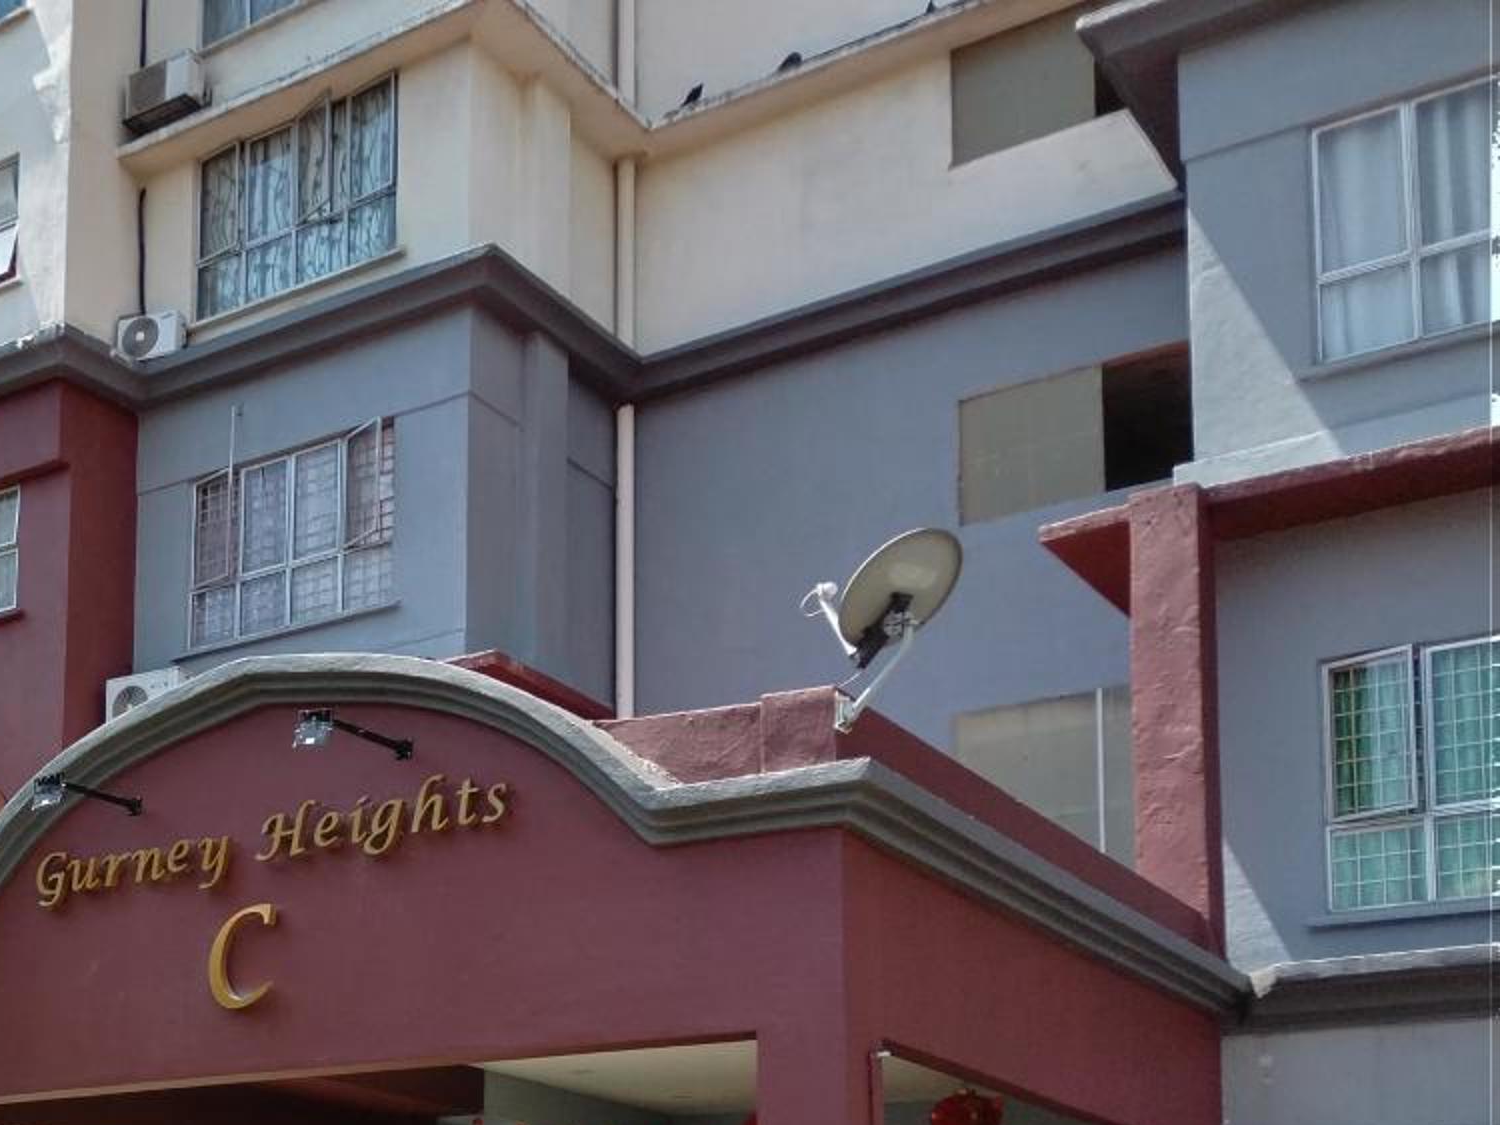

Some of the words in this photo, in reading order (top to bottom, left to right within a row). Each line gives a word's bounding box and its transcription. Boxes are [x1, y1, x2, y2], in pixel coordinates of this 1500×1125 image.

[36, 834, 230, 908] Gurney
[255, 774, 508, 861] Heights
[208, 903, 277, 1010] C
